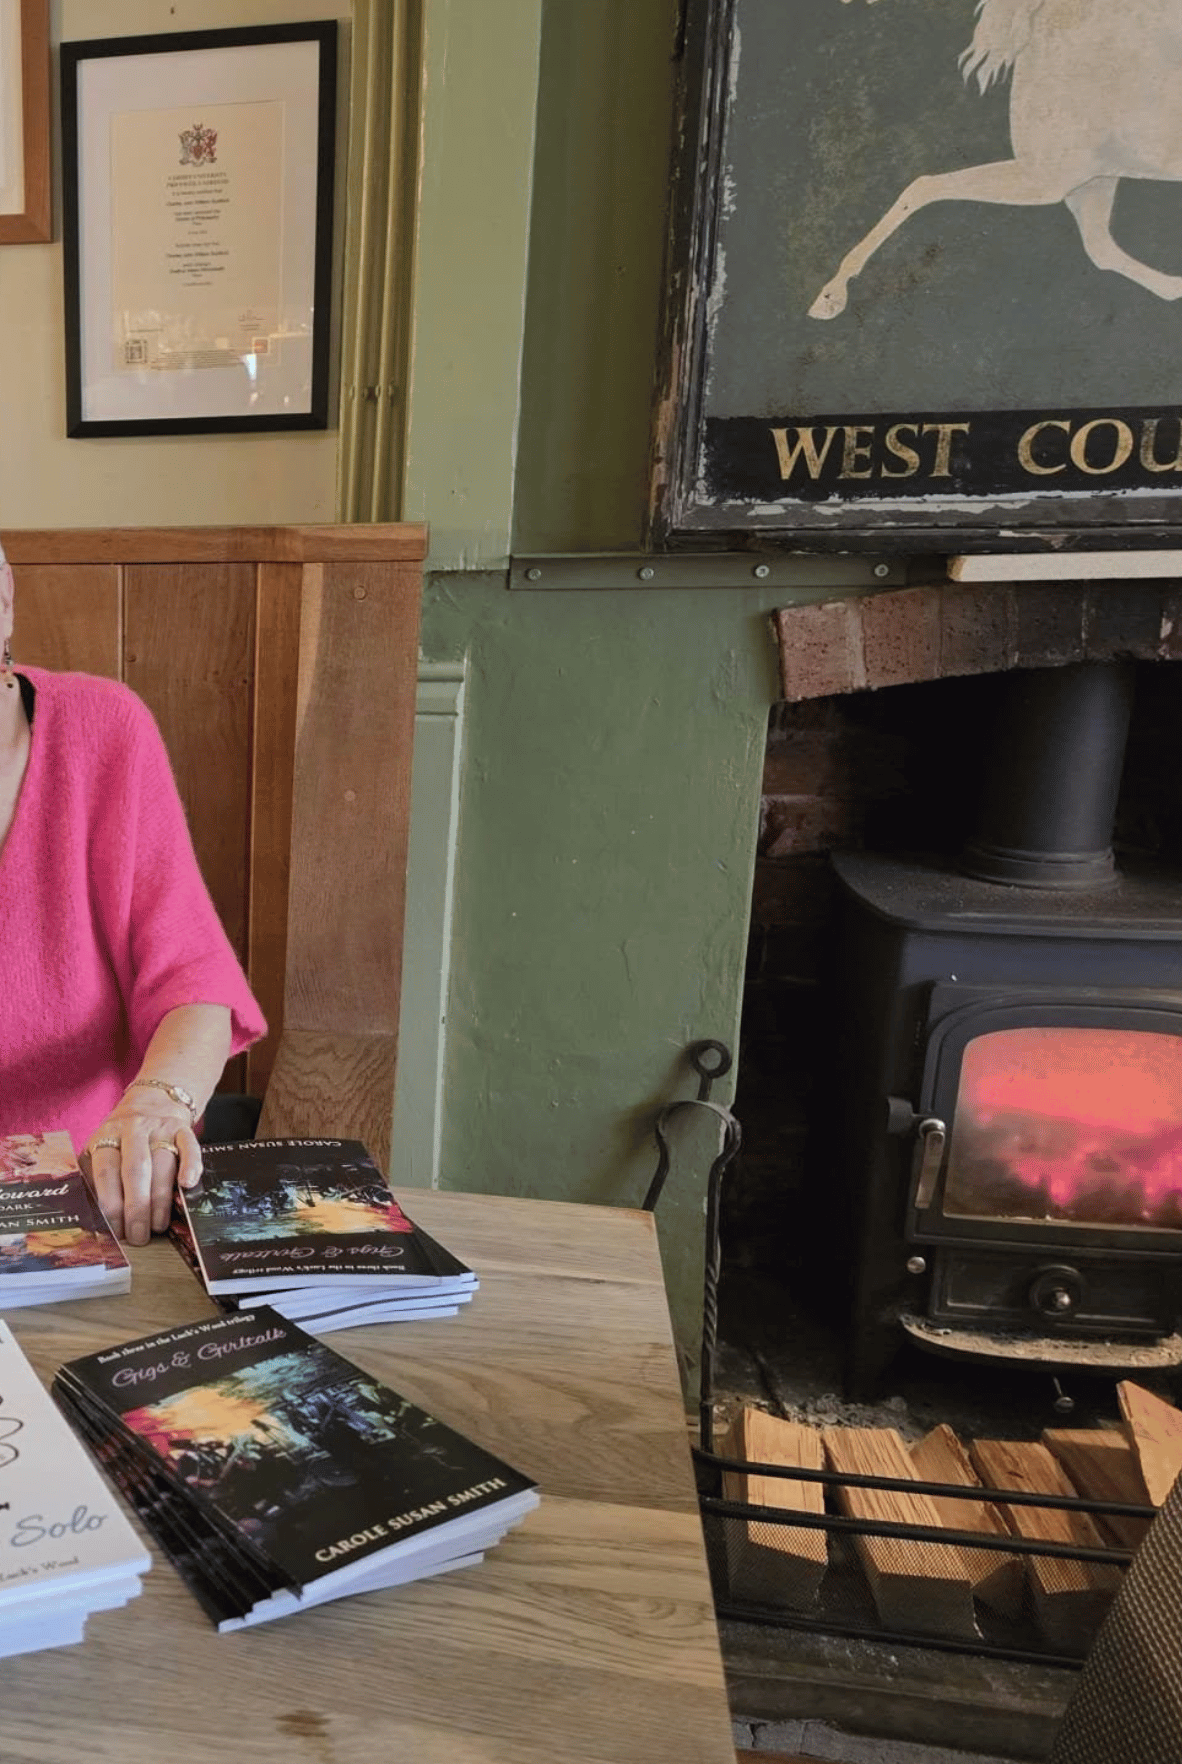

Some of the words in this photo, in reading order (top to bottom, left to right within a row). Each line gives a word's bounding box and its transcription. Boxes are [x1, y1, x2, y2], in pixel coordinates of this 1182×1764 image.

[770, 421, 970, 480] WEST
[1018, 418, 1182, 475] COU
[201, 1145, 234, 1153] SMIT
[238, 1140, 283, 1149] SUSAN
[26, 1215, 80, 1226] SMITH
[349, 1245, 405, 1258] Gigs
[226, 1313, 256, 1326] trilogy
[111, 1363, 169, 1387] Gigs
[171, 1351, 192, 1368] &
[197, 1328, 287, 1361] Girltalk
[10, 1504, 109, 1547] Solo
[315, 1524, 389, 1562] CAROLE
[387, 1501, 447, 1530] SUSAN
[447, 1477, 507, 1506] SMITH
[41, 1555, 79, 1570] Wood
